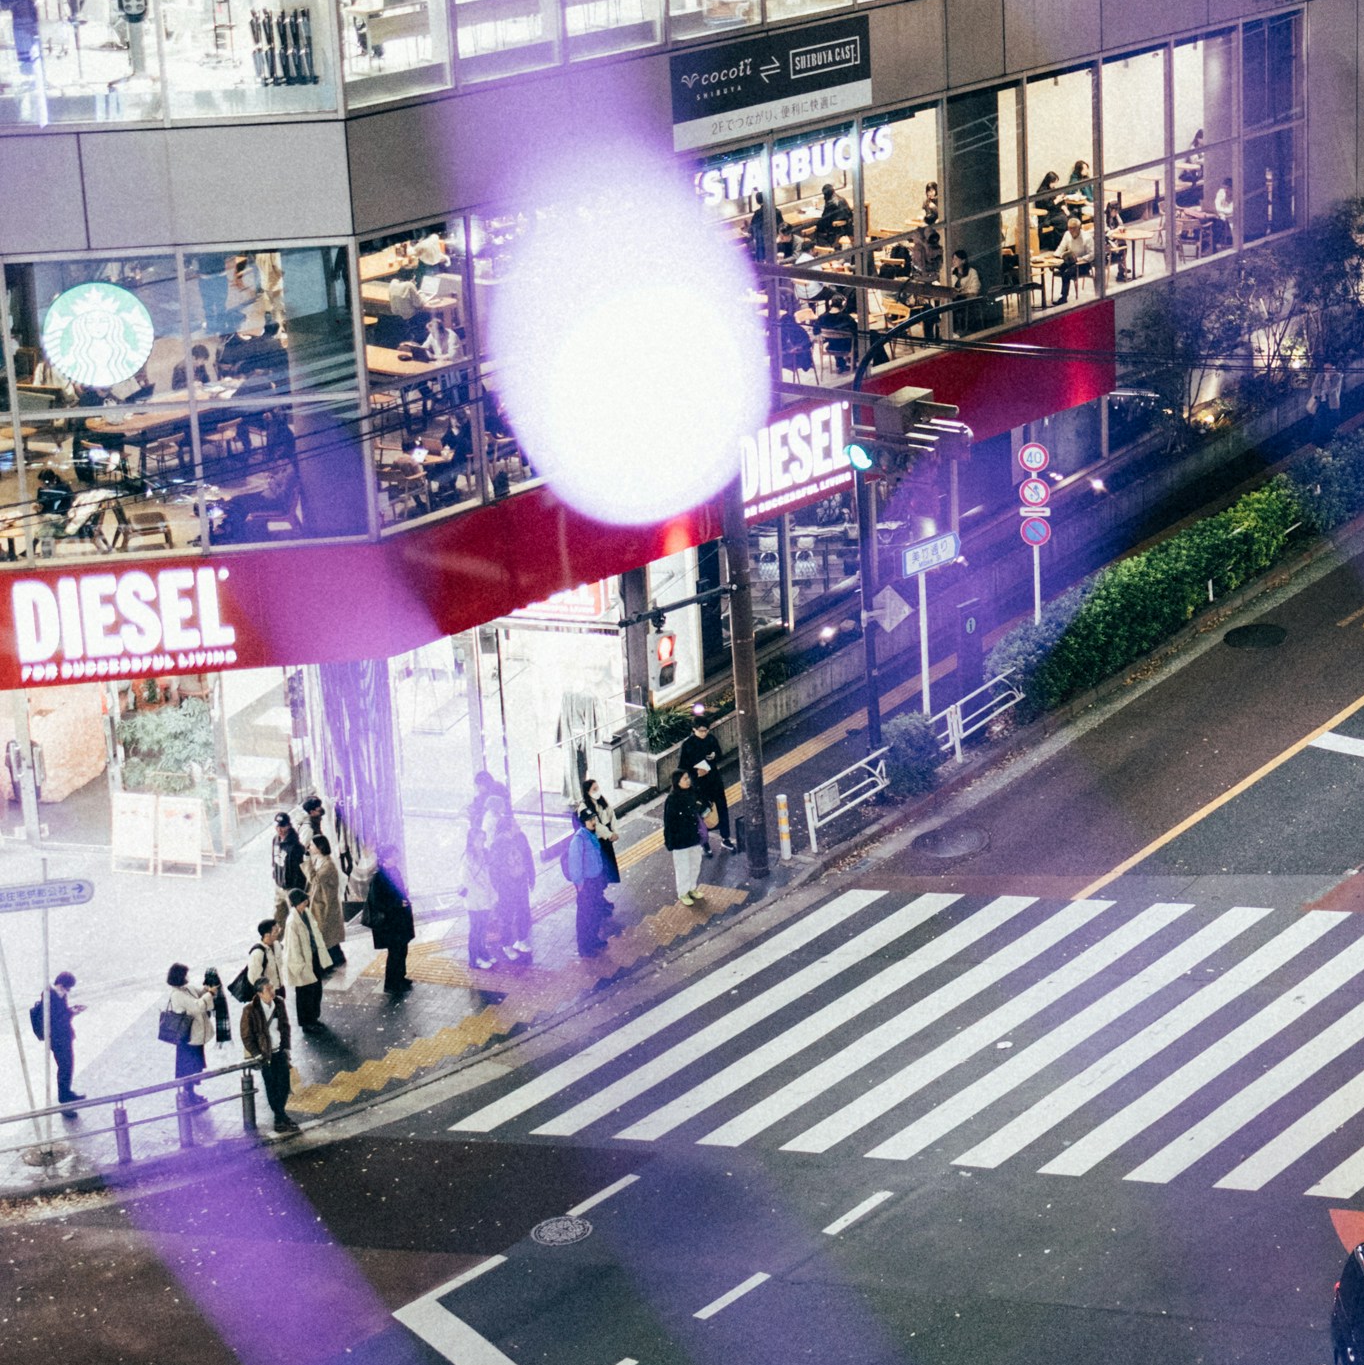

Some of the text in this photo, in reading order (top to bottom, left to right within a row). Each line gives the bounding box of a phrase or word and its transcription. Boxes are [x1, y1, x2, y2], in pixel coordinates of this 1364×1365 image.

[795, 50, 833, 70] SHIBUYA
[696, 85, 742, 101] SHIBUYA
[702, 127, 893, 206] STARBUCKS
[741, 402, 851, 503] DIESEL
[1026, 451, 1042, 464] 40
[12, 566, 236, 664] DIESEL
